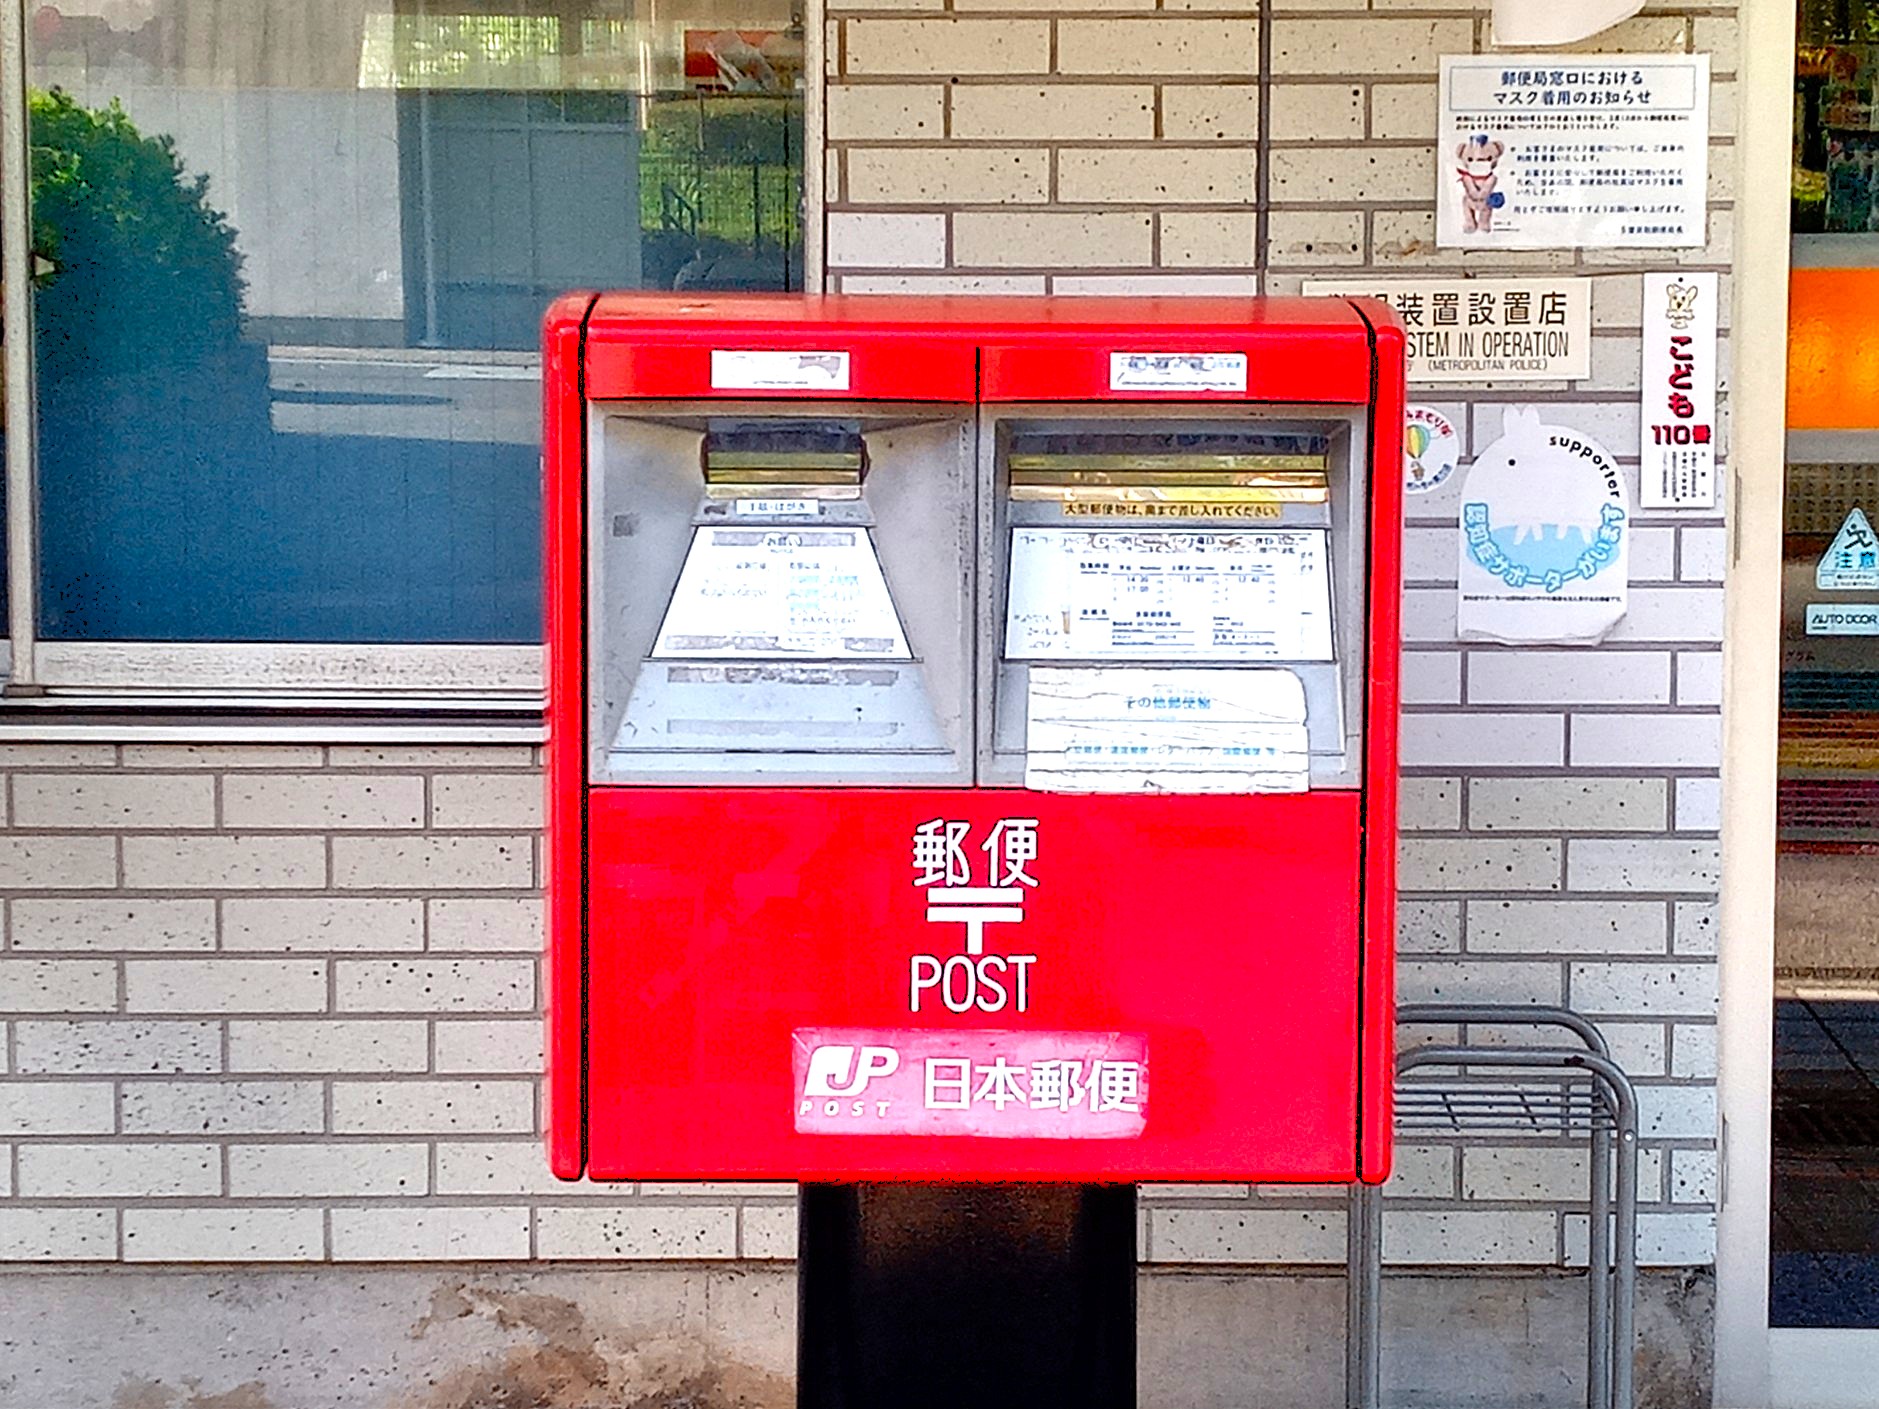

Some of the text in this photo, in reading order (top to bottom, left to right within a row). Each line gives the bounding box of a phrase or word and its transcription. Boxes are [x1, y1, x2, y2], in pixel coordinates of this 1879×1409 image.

[1493, 90, 1652, 106] マスク着用のお知らせ
[1501, 71, 1644, 87] 郵便局窓口における
[1428, 359, 1549, 371] (METROPOLITAN POLICE)
[1458, 332, 1476, 358] IN
[1482, 331, 1569, 358] OPERATION
[1668, 336, 1695, 418] こども
[1549, 436, 1620, 498] supporter
[1464, 503, 1625, 593] 認知症サポーターがいます
[1812, 614, 1844, 624] AUTO
[912, 818, 1039, 888] 郵便
[910, 954, 1036, 1013] POST
[924, 1056, 1139, 1113] 日本郵便
[799, 1101, 891, 1117] POST
